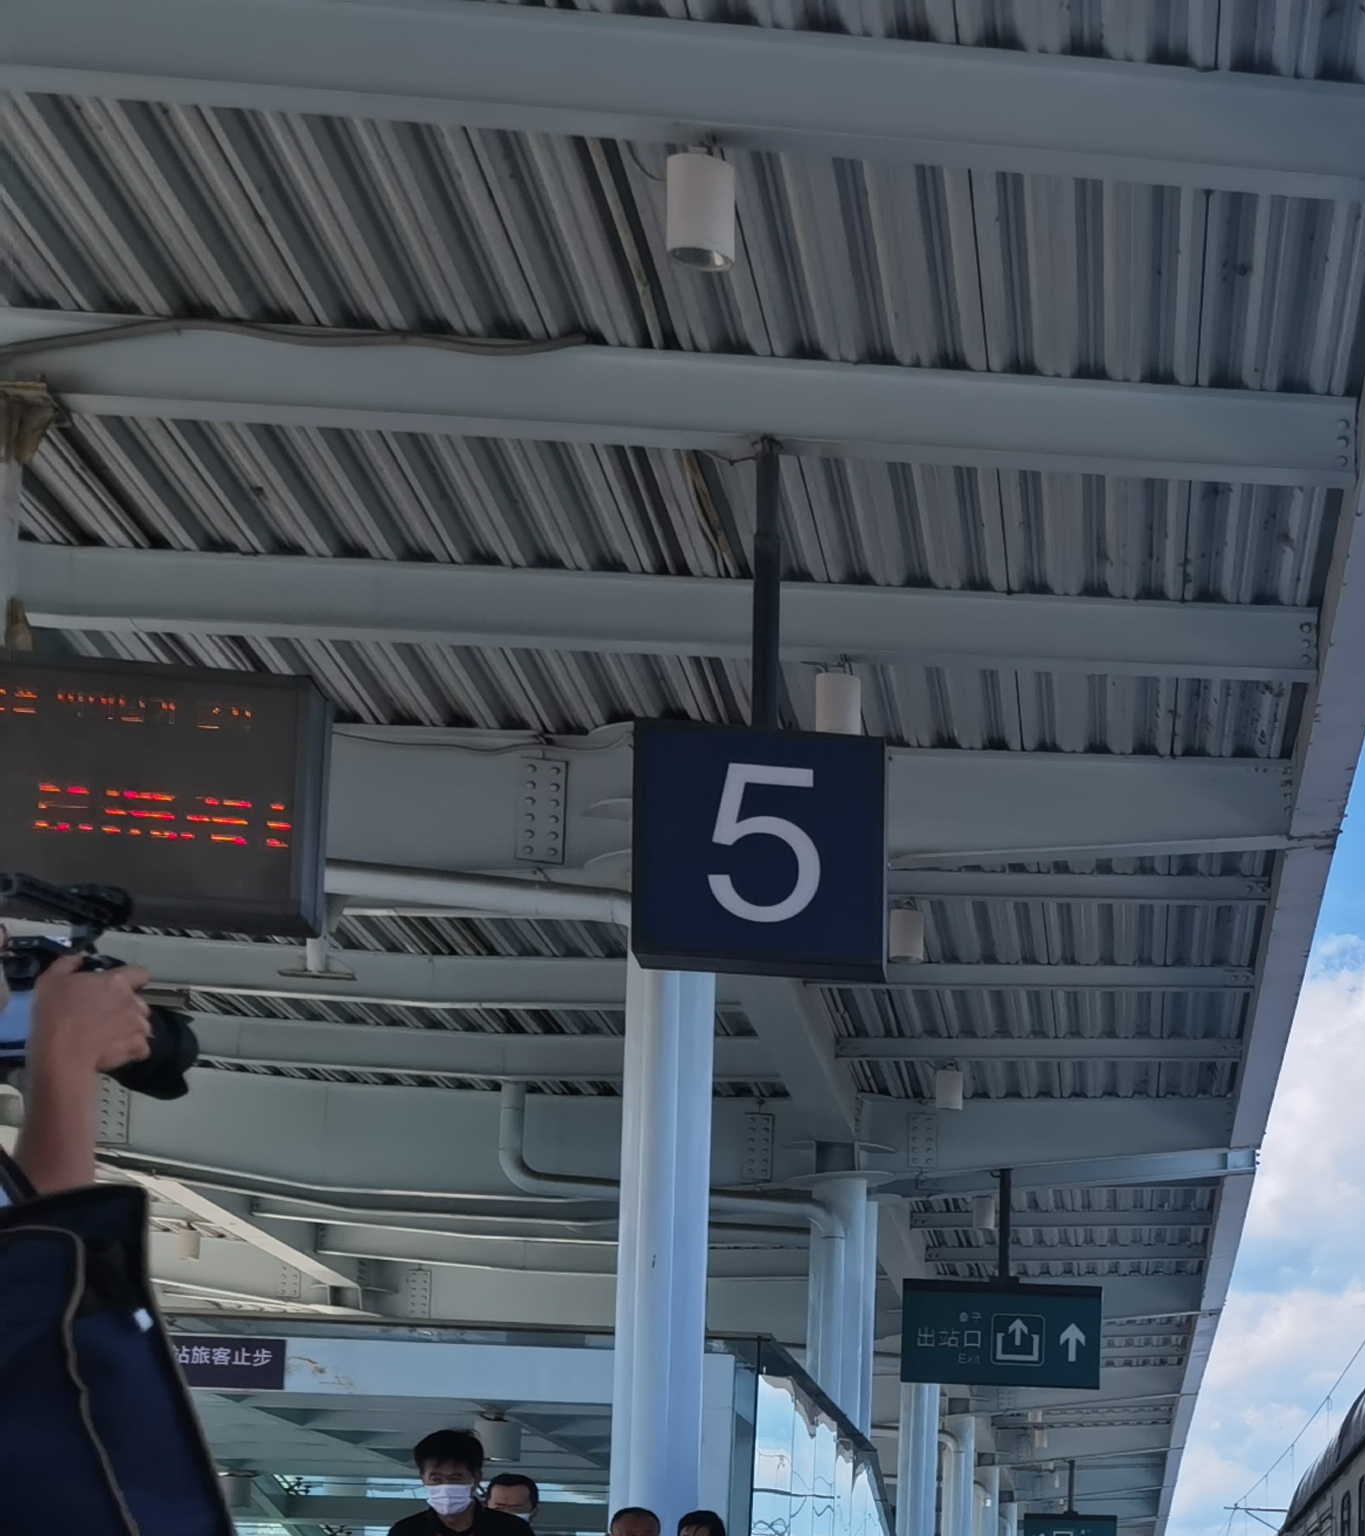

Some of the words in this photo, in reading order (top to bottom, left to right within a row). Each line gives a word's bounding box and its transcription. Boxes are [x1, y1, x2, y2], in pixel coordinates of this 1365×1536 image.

[707, 762, 821, 923] 5
[916, 1327, 981, 1348] 出站口
[958, 1353, 981, 1364] Exit
